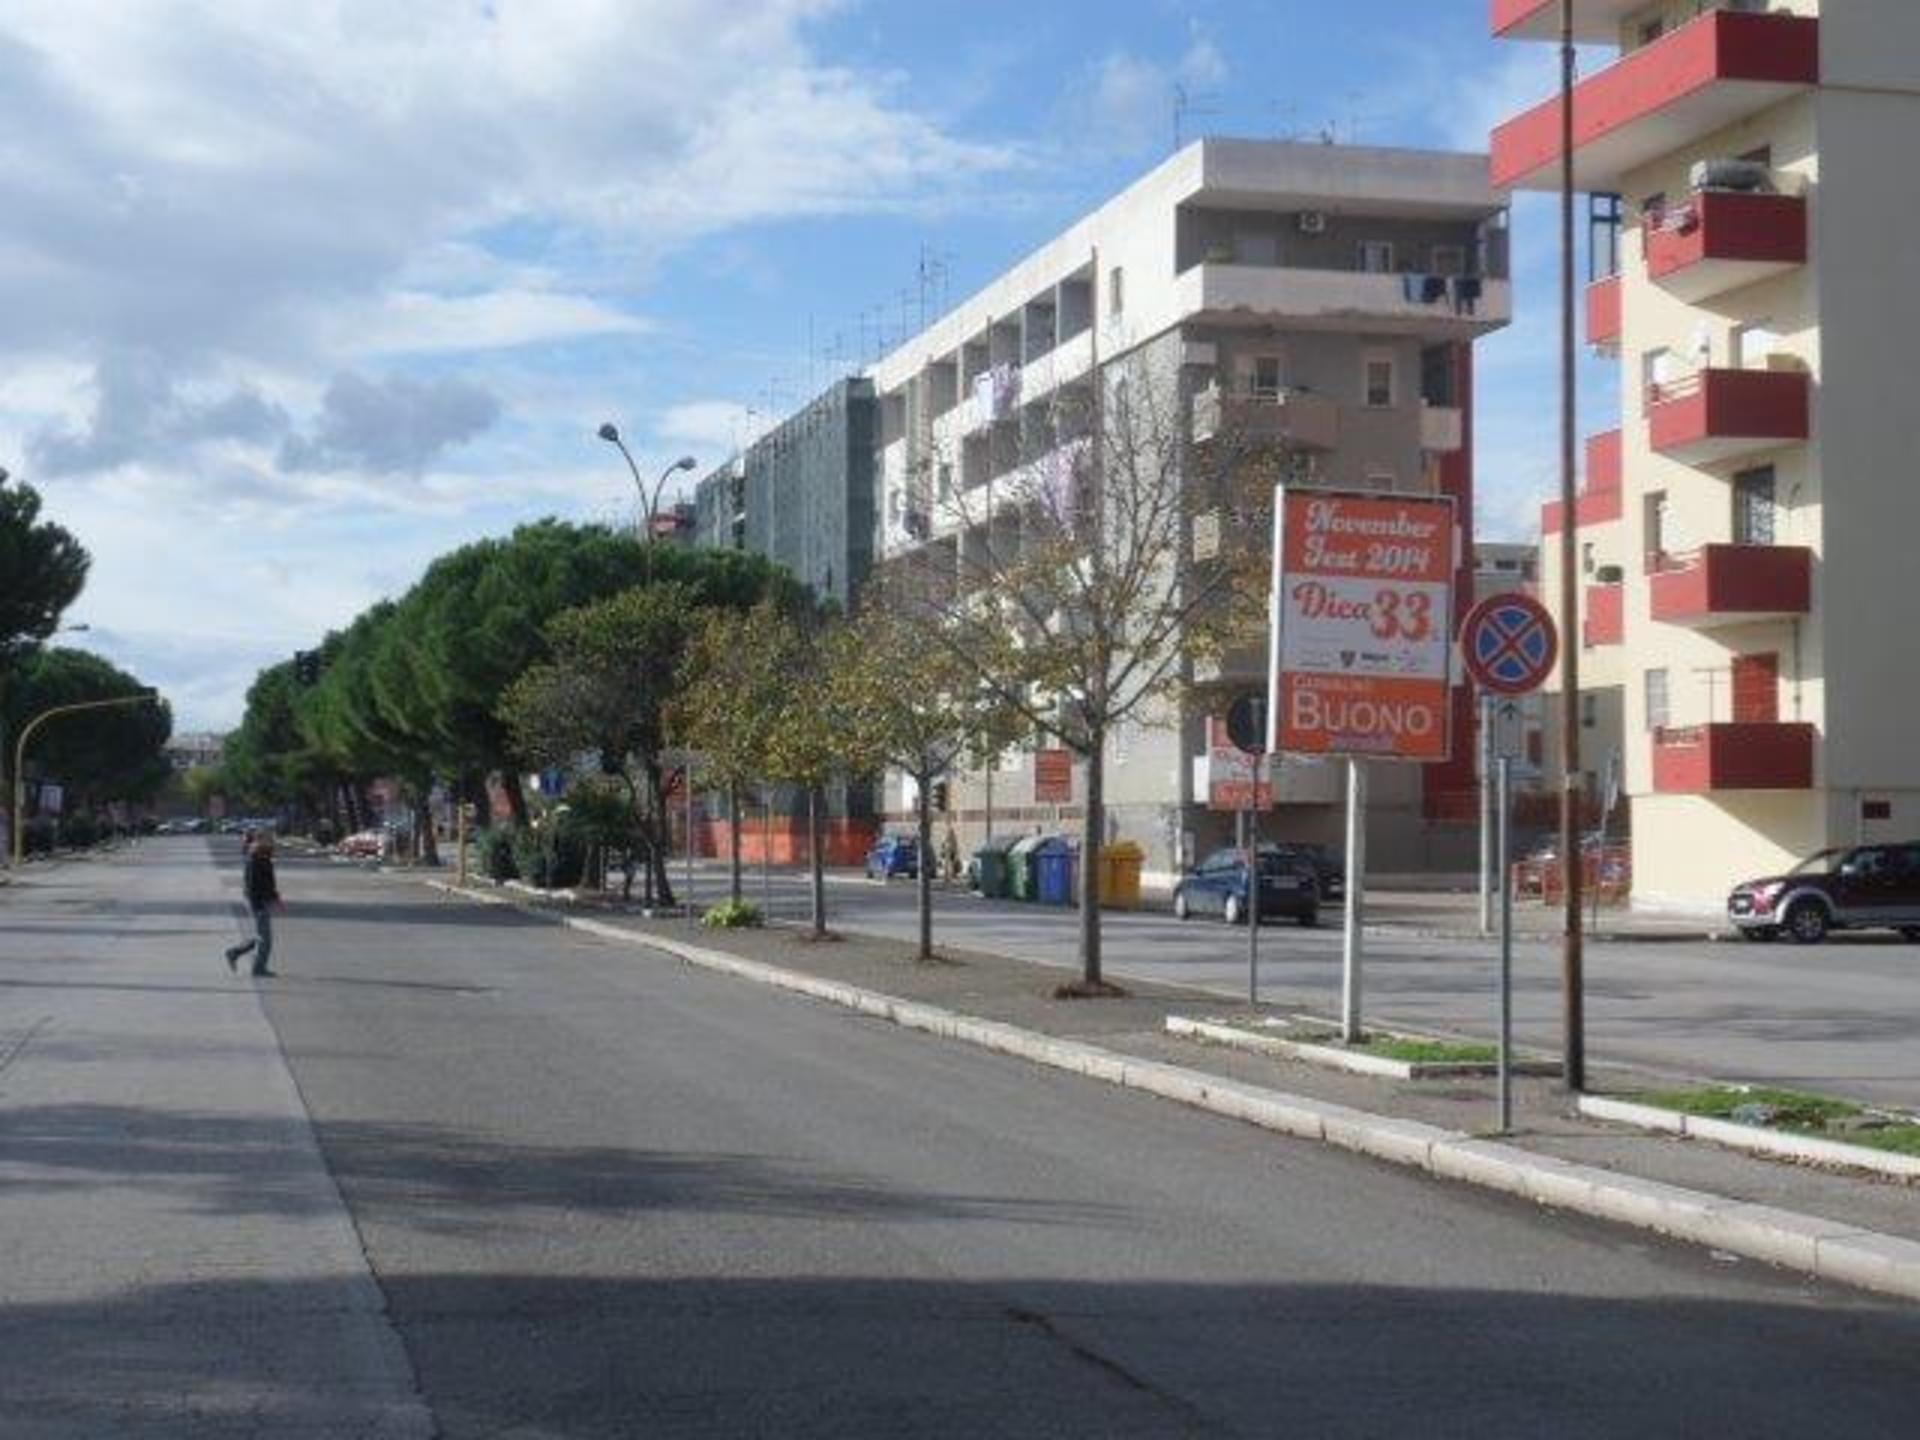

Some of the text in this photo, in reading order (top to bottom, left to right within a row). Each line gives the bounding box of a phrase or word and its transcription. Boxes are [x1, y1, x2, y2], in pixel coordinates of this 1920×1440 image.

[1303, 501, 1438, 538] November
[1365, 542, 1431, 573] 2014
[1293, 581, 1433, 641] Dica 33
